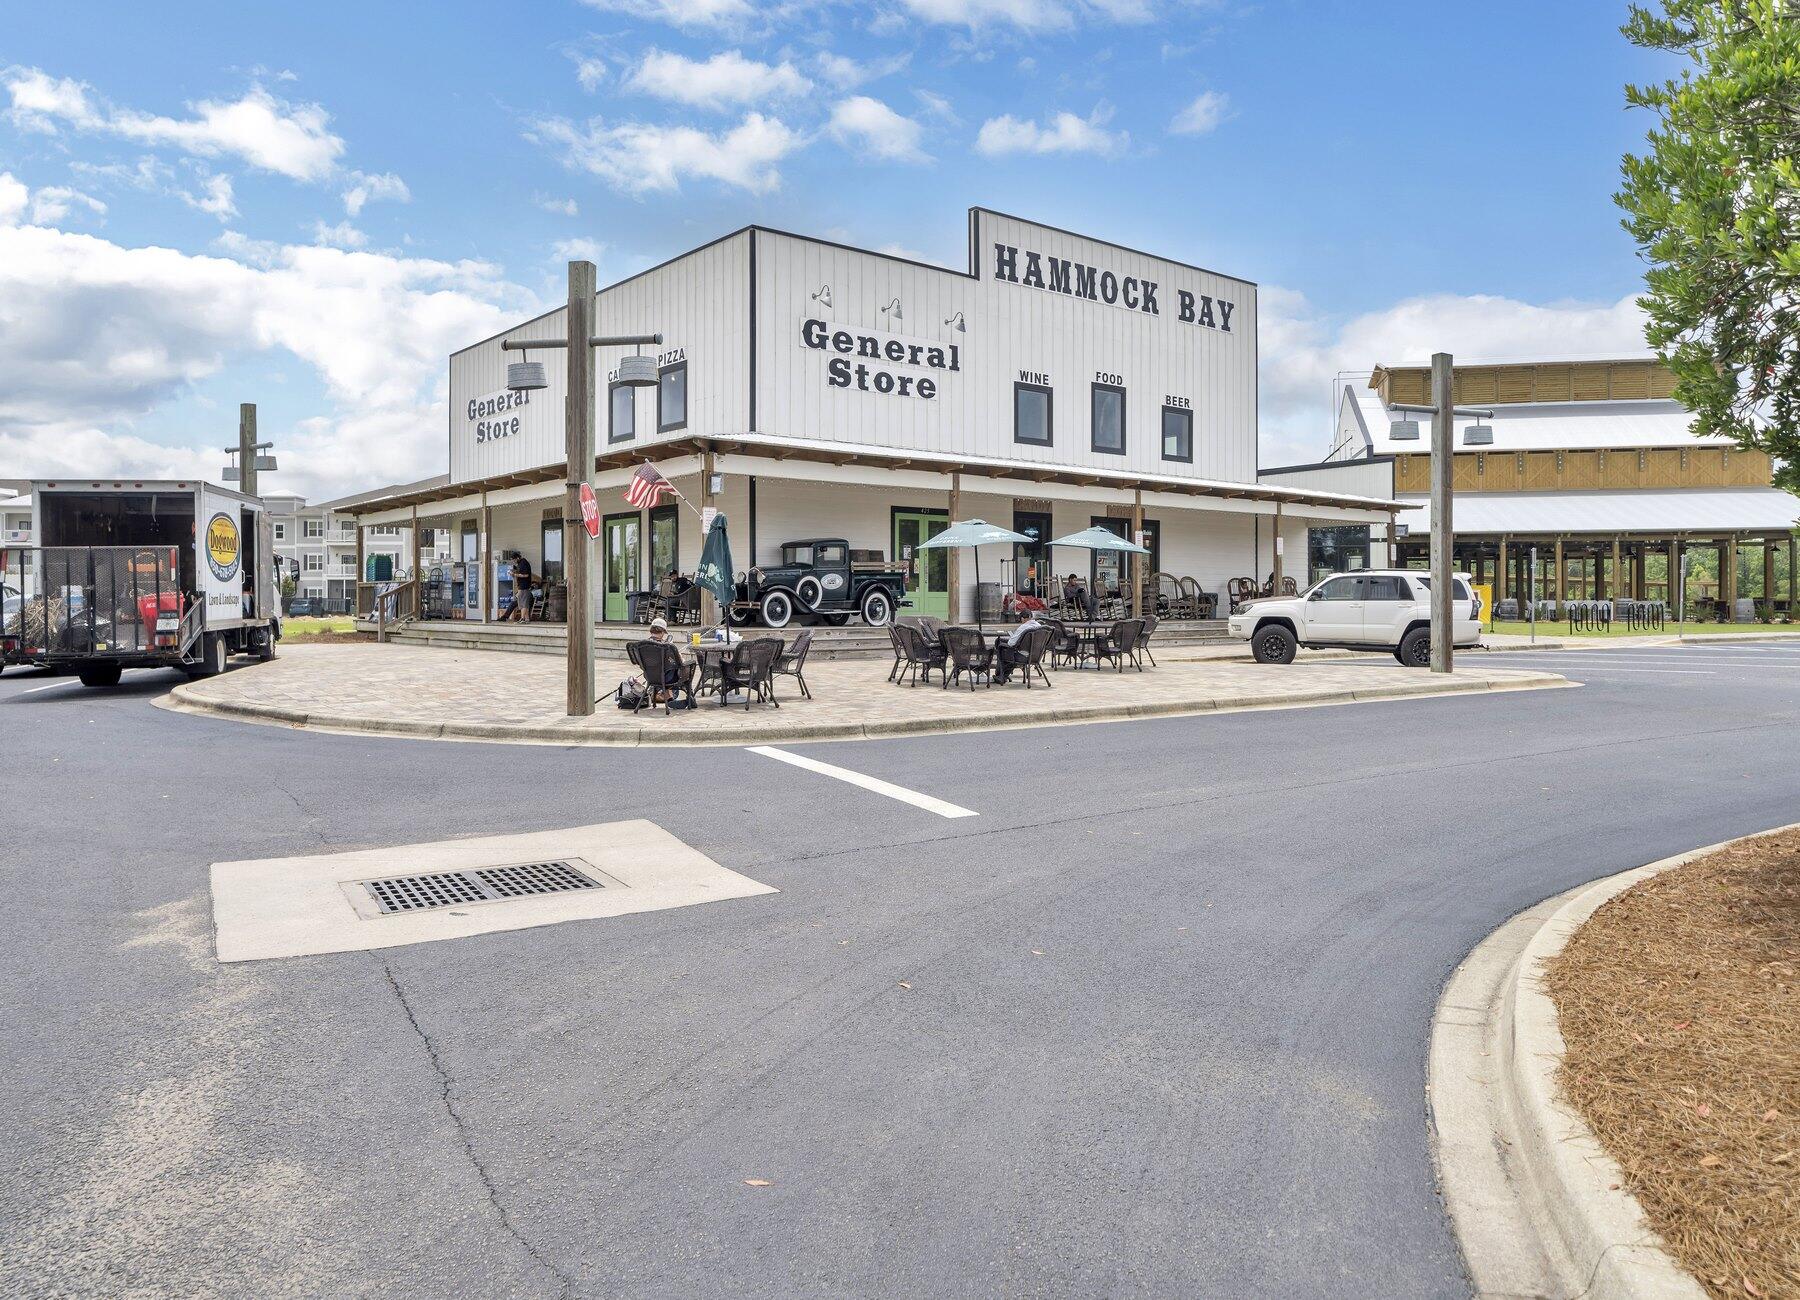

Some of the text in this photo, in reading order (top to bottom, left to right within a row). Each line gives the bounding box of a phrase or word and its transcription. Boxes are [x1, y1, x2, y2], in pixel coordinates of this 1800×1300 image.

[995, 243, 1235, 333] HAMMOCK BAY
[802, 318, 960, 372] General
[658, 348, 686, 366] PIZZA
[828, 358, 938, 399] Store
[1019, 370, 1049, 386] WINE
[1096, 371, 1123, 386] FOOD
[467, 389, 530, 421] General
[1165, 395, 1190, 408] BEER
[477, 417, 519, 444] Store
[582, 500, 598, 522] STOP
[210, 529, 237, 554] Dogwood
[209, 593, 219, 606] Lawn
[222, 593, 240, 607] Landscape
